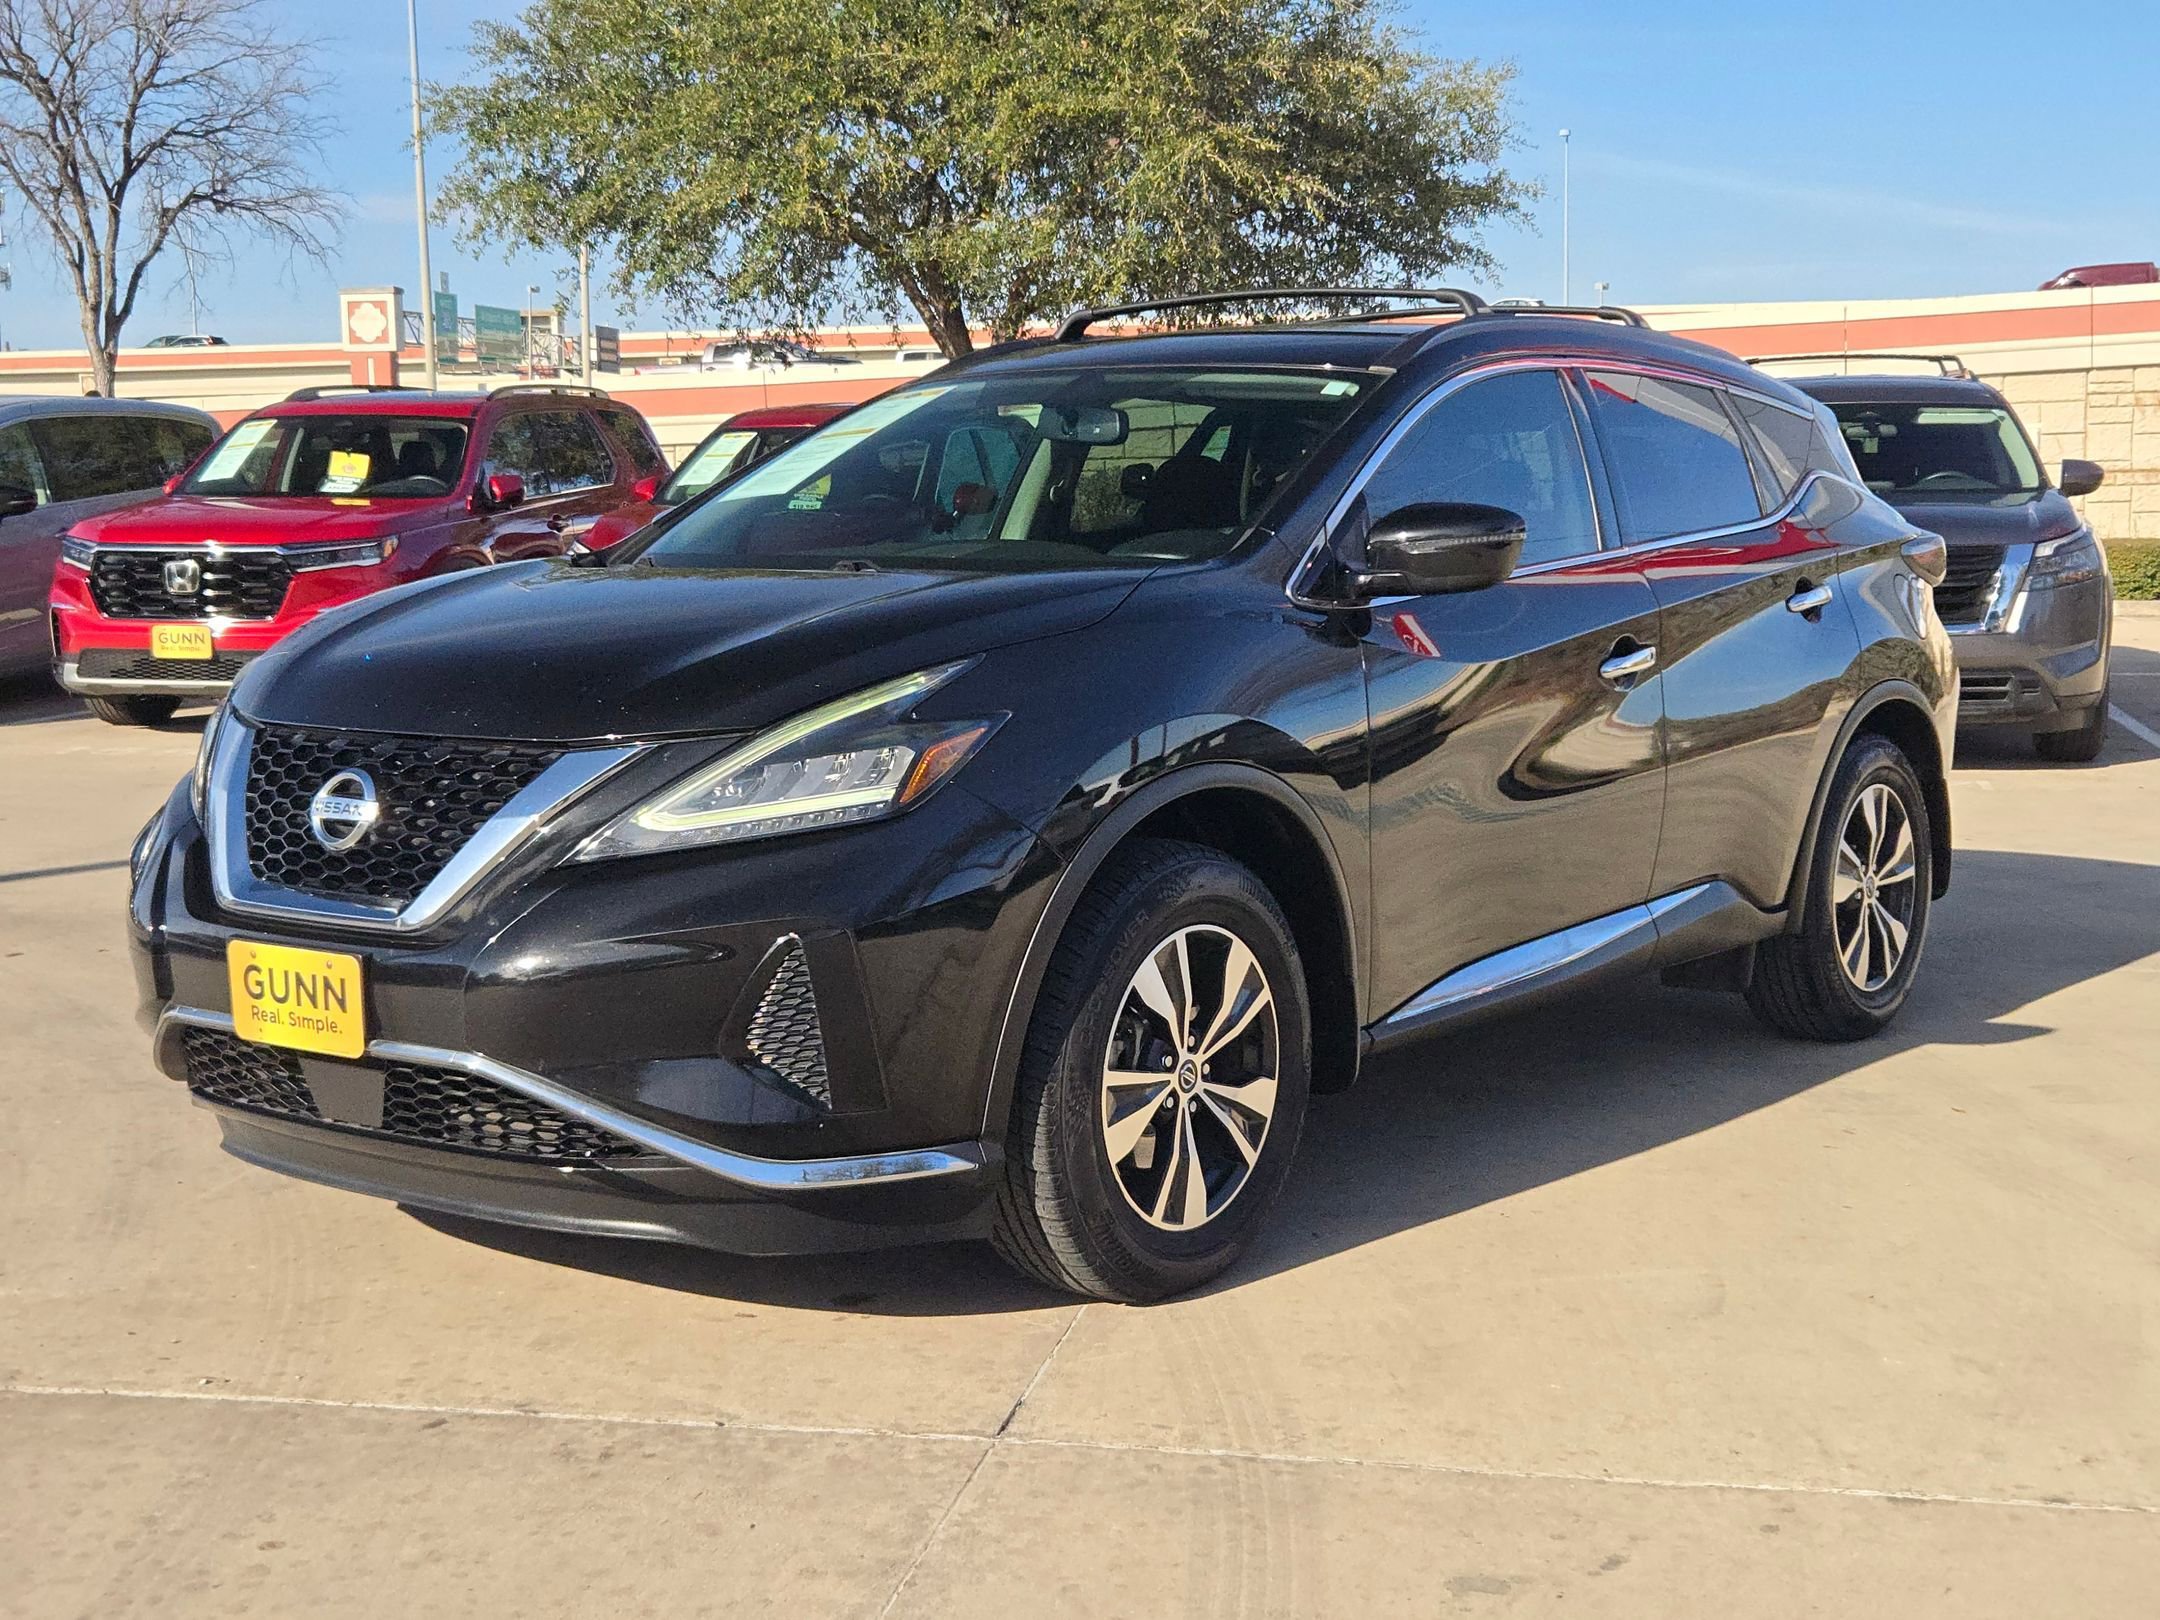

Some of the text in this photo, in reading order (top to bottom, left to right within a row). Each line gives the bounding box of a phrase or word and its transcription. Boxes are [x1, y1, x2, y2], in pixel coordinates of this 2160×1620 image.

[158, 632, 205, 644] GUNN
[243, 964, 348, 1013] GUNN
[251, 1005, 343, 1035] Real. Simple.
